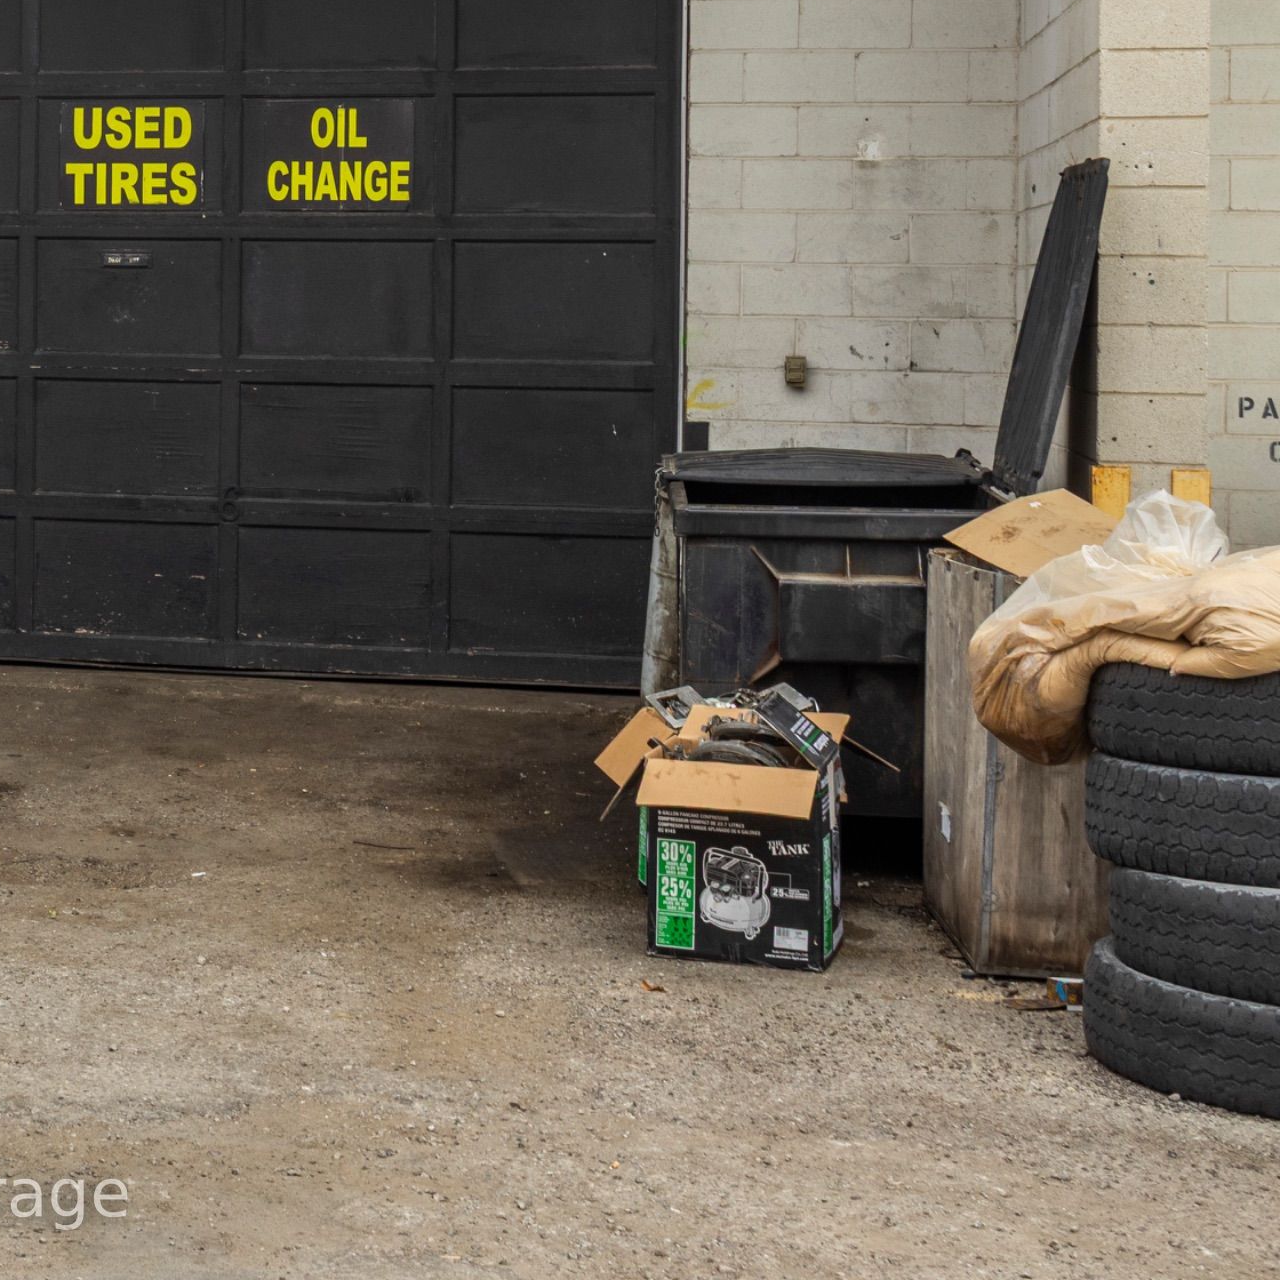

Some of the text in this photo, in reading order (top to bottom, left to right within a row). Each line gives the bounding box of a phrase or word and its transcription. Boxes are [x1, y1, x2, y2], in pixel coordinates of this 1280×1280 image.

[72, 106, 192, 150] USED
[310, 107, 368, 148] OIL
[65, 162, 198, 205] TIRES
[267, 160, 411, 202] CHANGE
[661, 841, 692, 863] 30%
[770, 843, 810, 856] TANK
[661, 876, 691, 898] 25%
